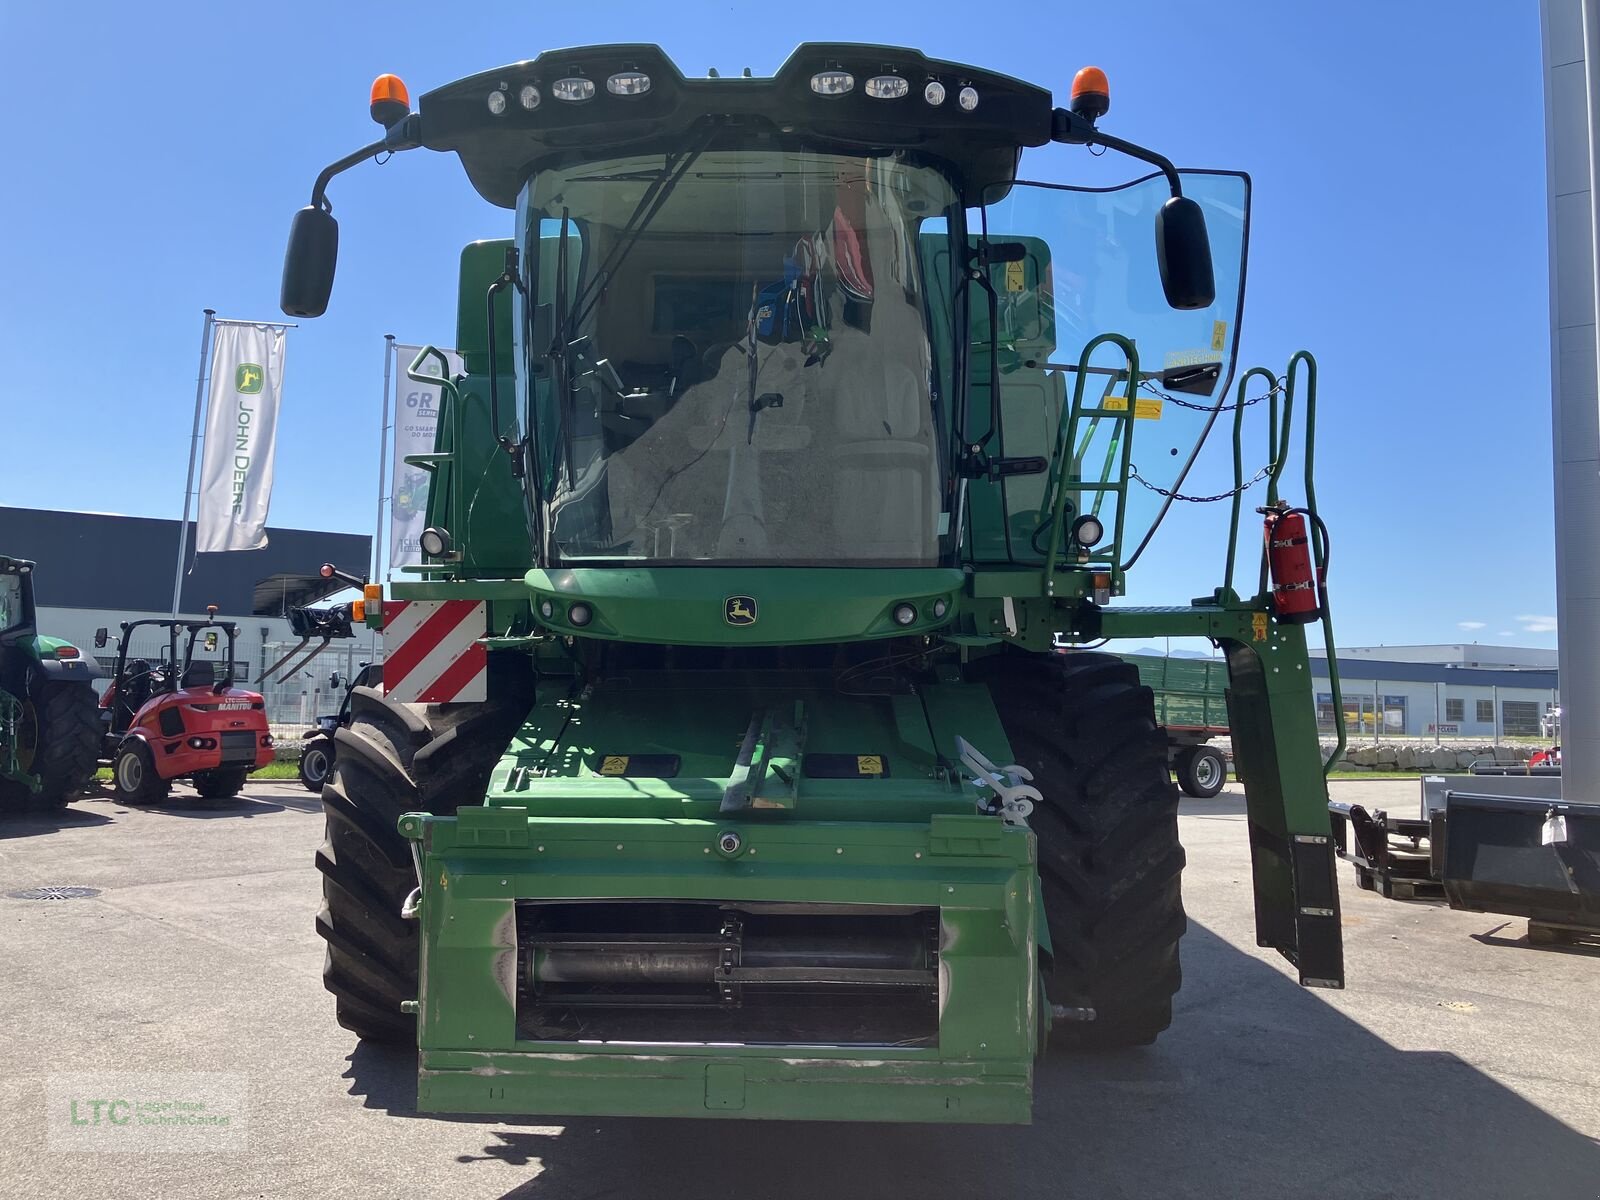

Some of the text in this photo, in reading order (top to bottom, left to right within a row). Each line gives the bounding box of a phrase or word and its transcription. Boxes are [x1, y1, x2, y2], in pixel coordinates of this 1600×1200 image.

[406, 392, 433, 408] 6R
[231, 401, 254, 515] JOHN DEERE
[218, 703, 252, 711] MANITOU
